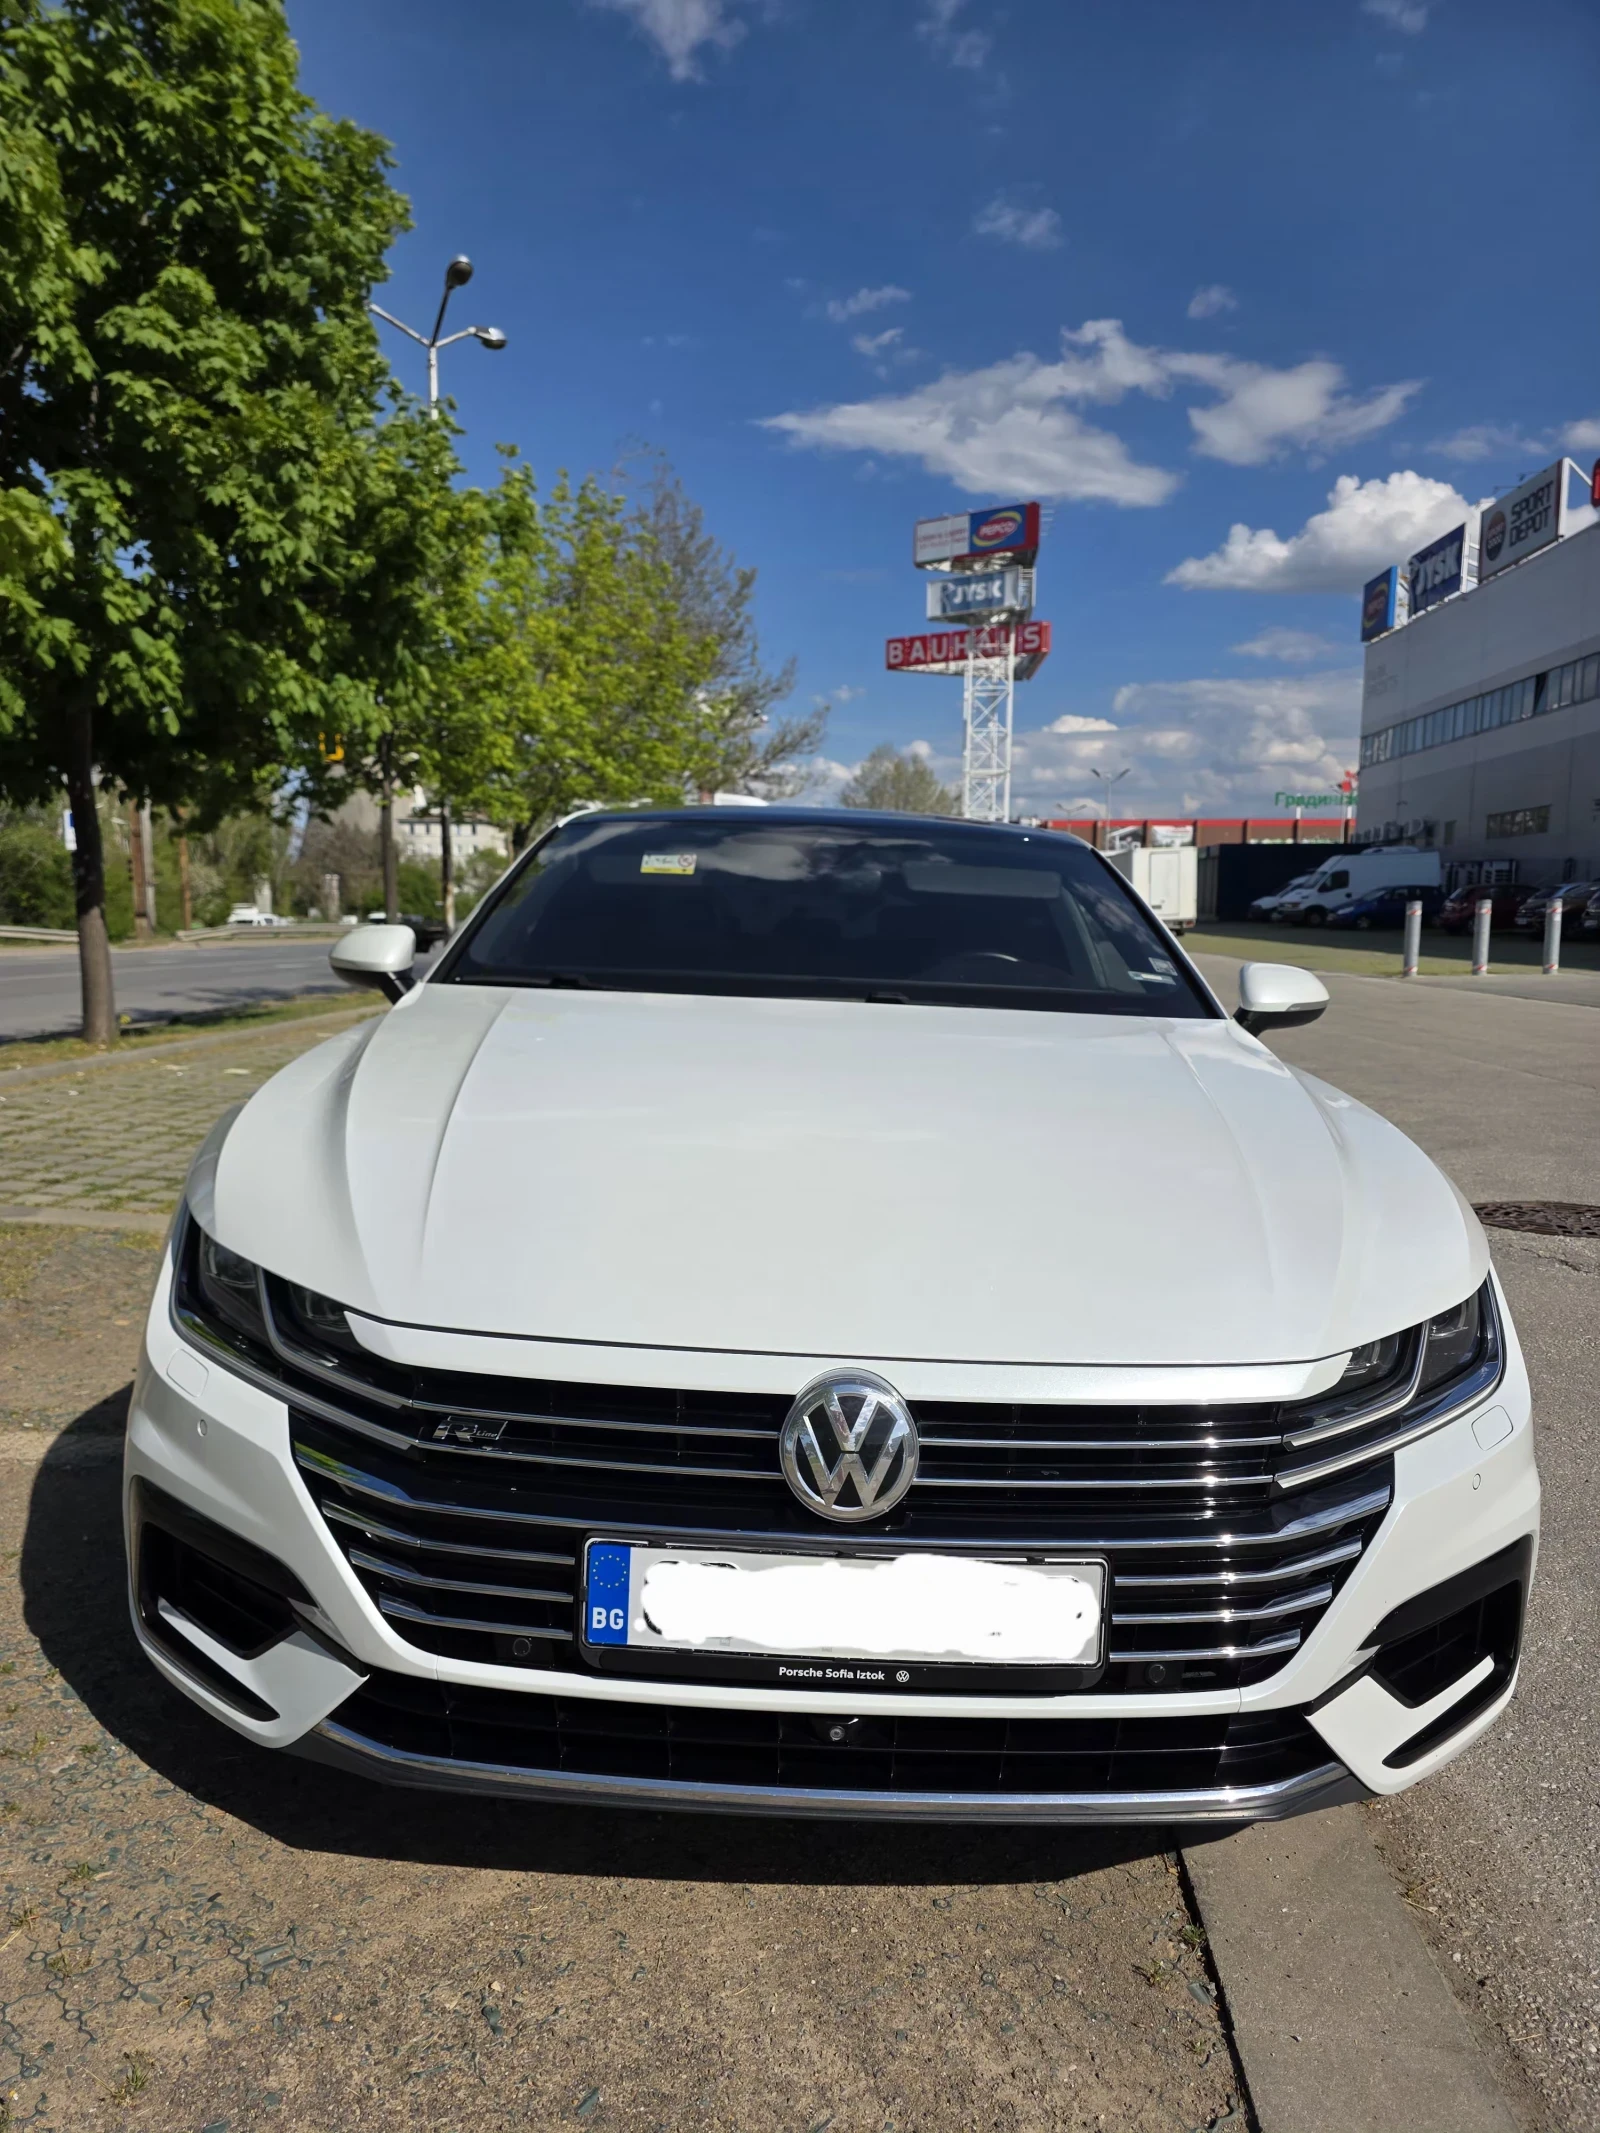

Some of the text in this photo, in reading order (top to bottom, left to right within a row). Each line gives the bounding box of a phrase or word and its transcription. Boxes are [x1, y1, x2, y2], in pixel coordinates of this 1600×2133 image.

[1510, 480, 1553, 524] SPORT
[1508, 504, 1551, 547] DEPOT
[1415, 540, 1460, 595] JYSK
[952, 579, 1003, 604] JYSK
[592, 1606, 624, 1630] BG
[778, 1666, 823, 1678] Porsche
[825, 1668, 854, 1680] Sofia
[856, 1669, 885, 1681] Iztok
